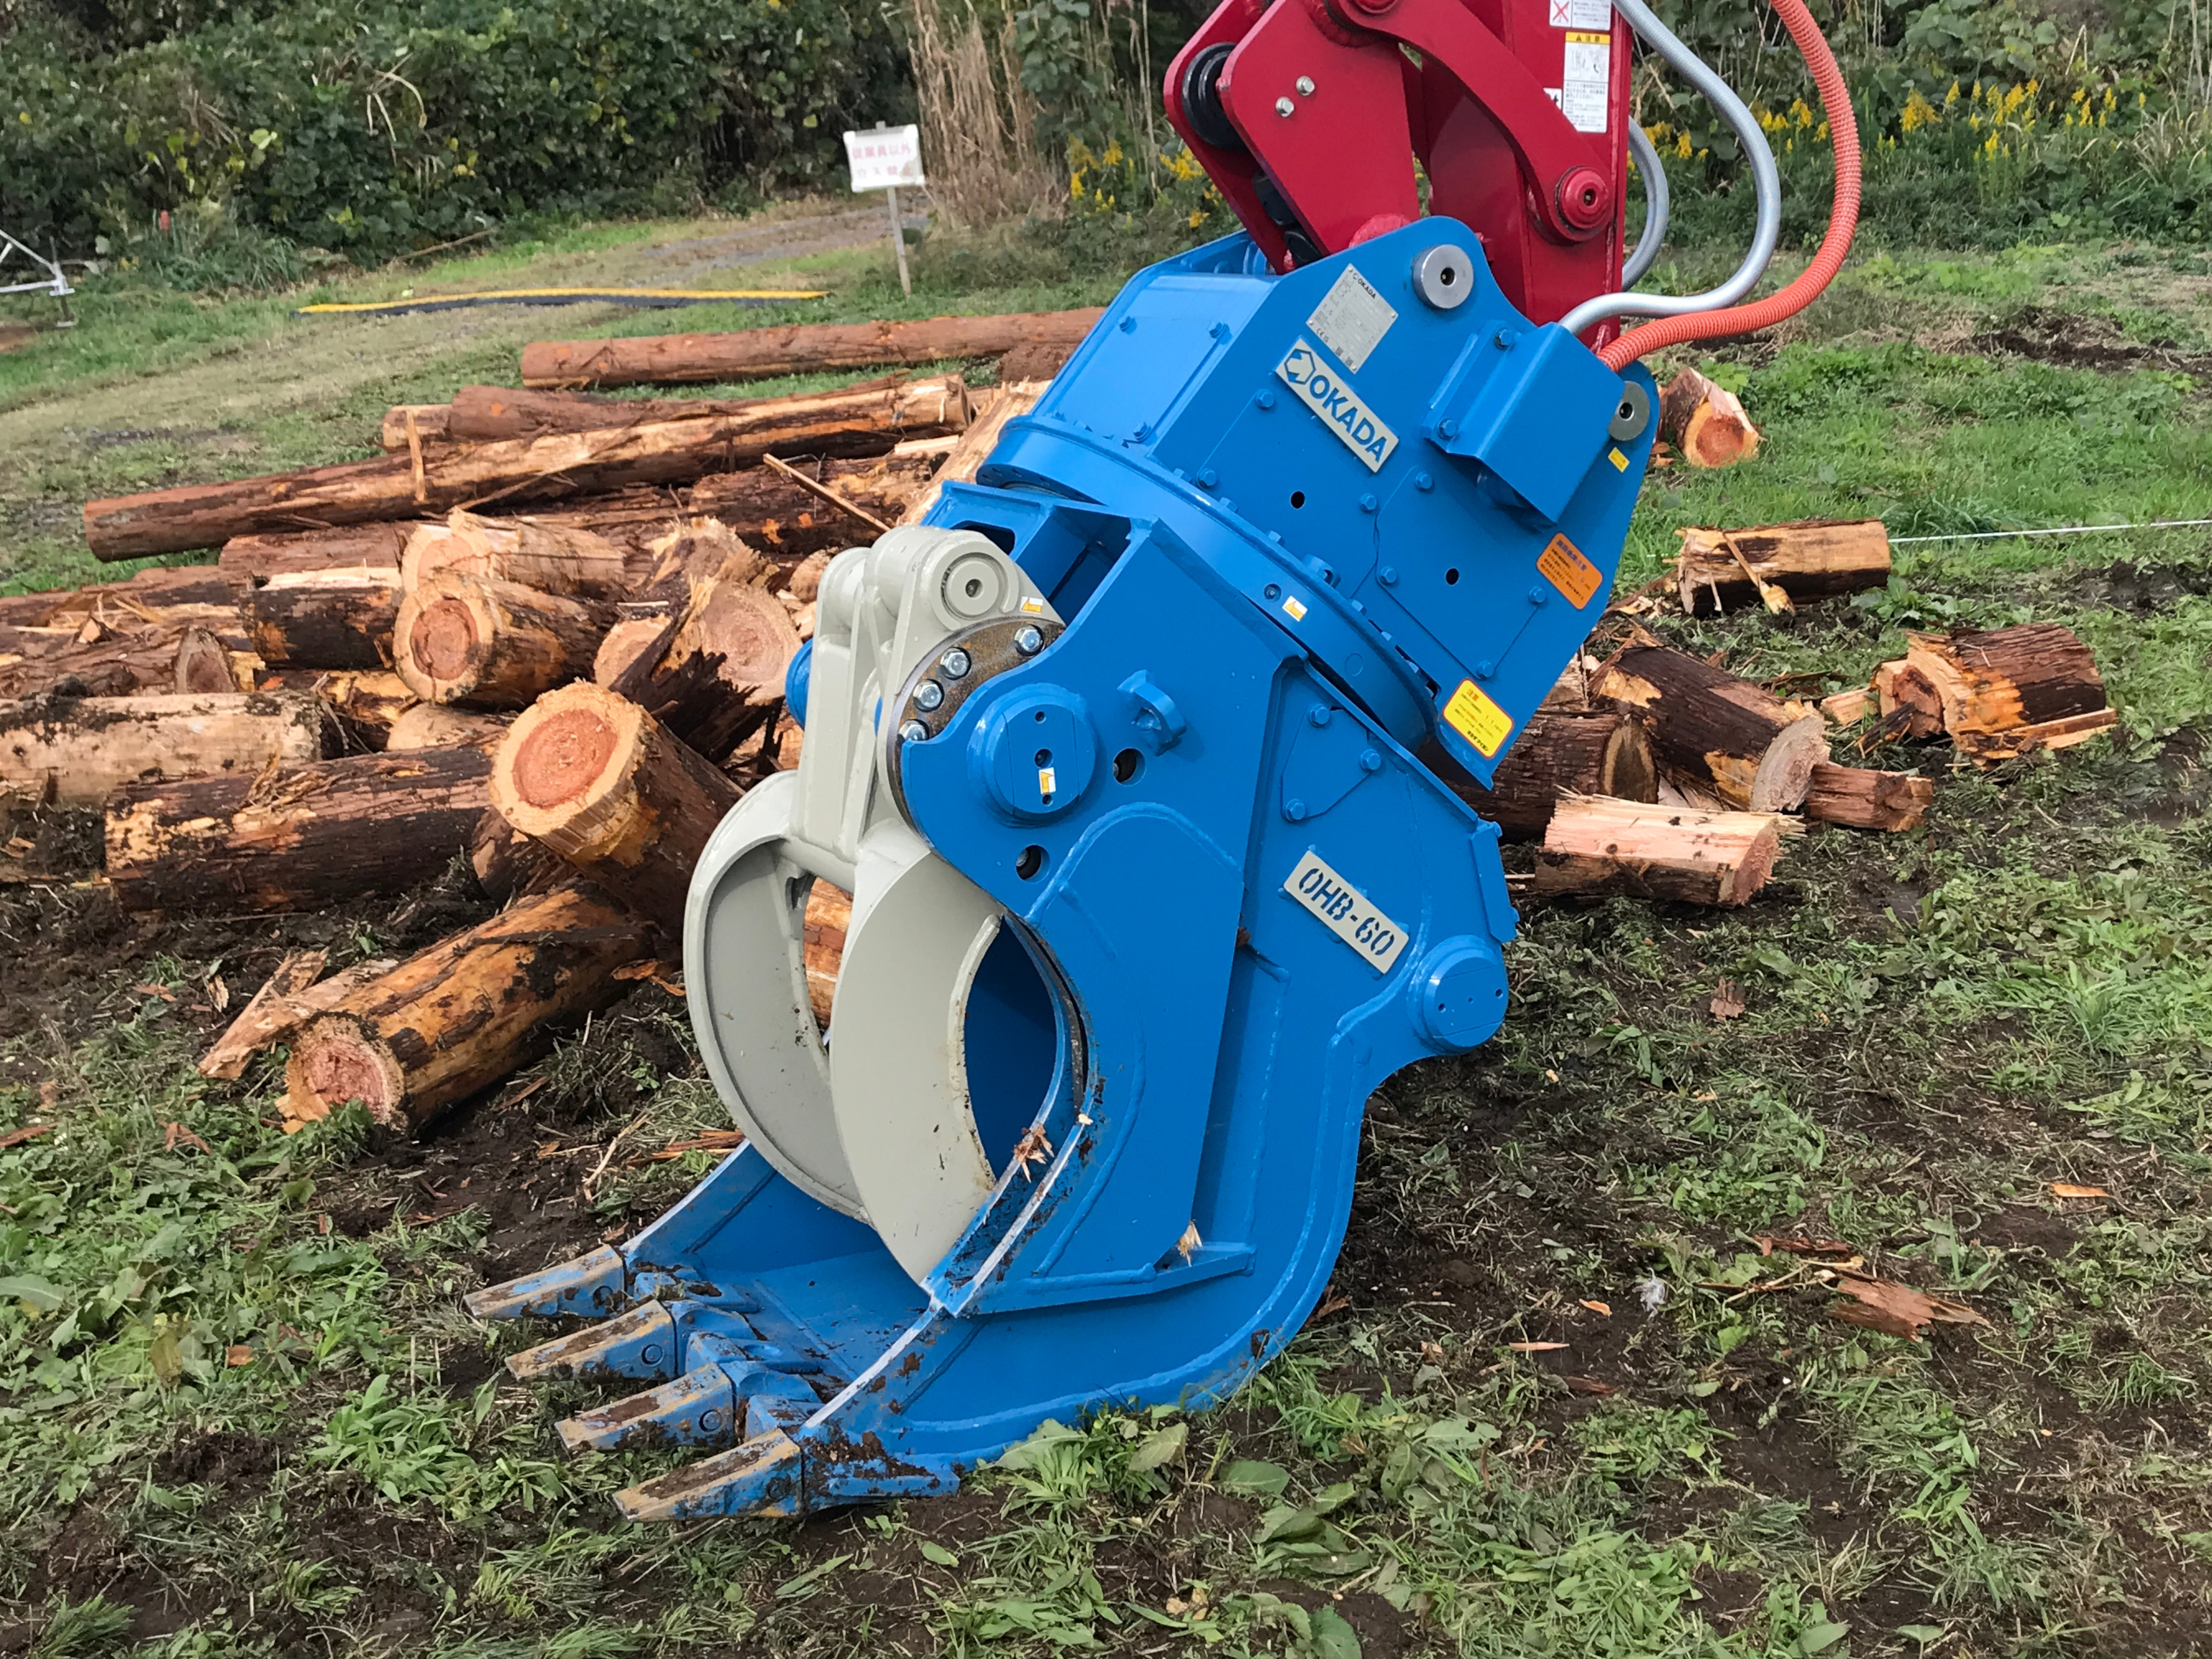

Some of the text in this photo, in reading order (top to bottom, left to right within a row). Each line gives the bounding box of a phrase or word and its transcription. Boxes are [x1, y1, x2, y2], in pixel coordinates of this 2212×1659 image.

[1358, 278, 1376, 299] OKADA
[1309, 375, 1387, 463] OKADA
[1299, 868, 1395, 955] OHB-60
